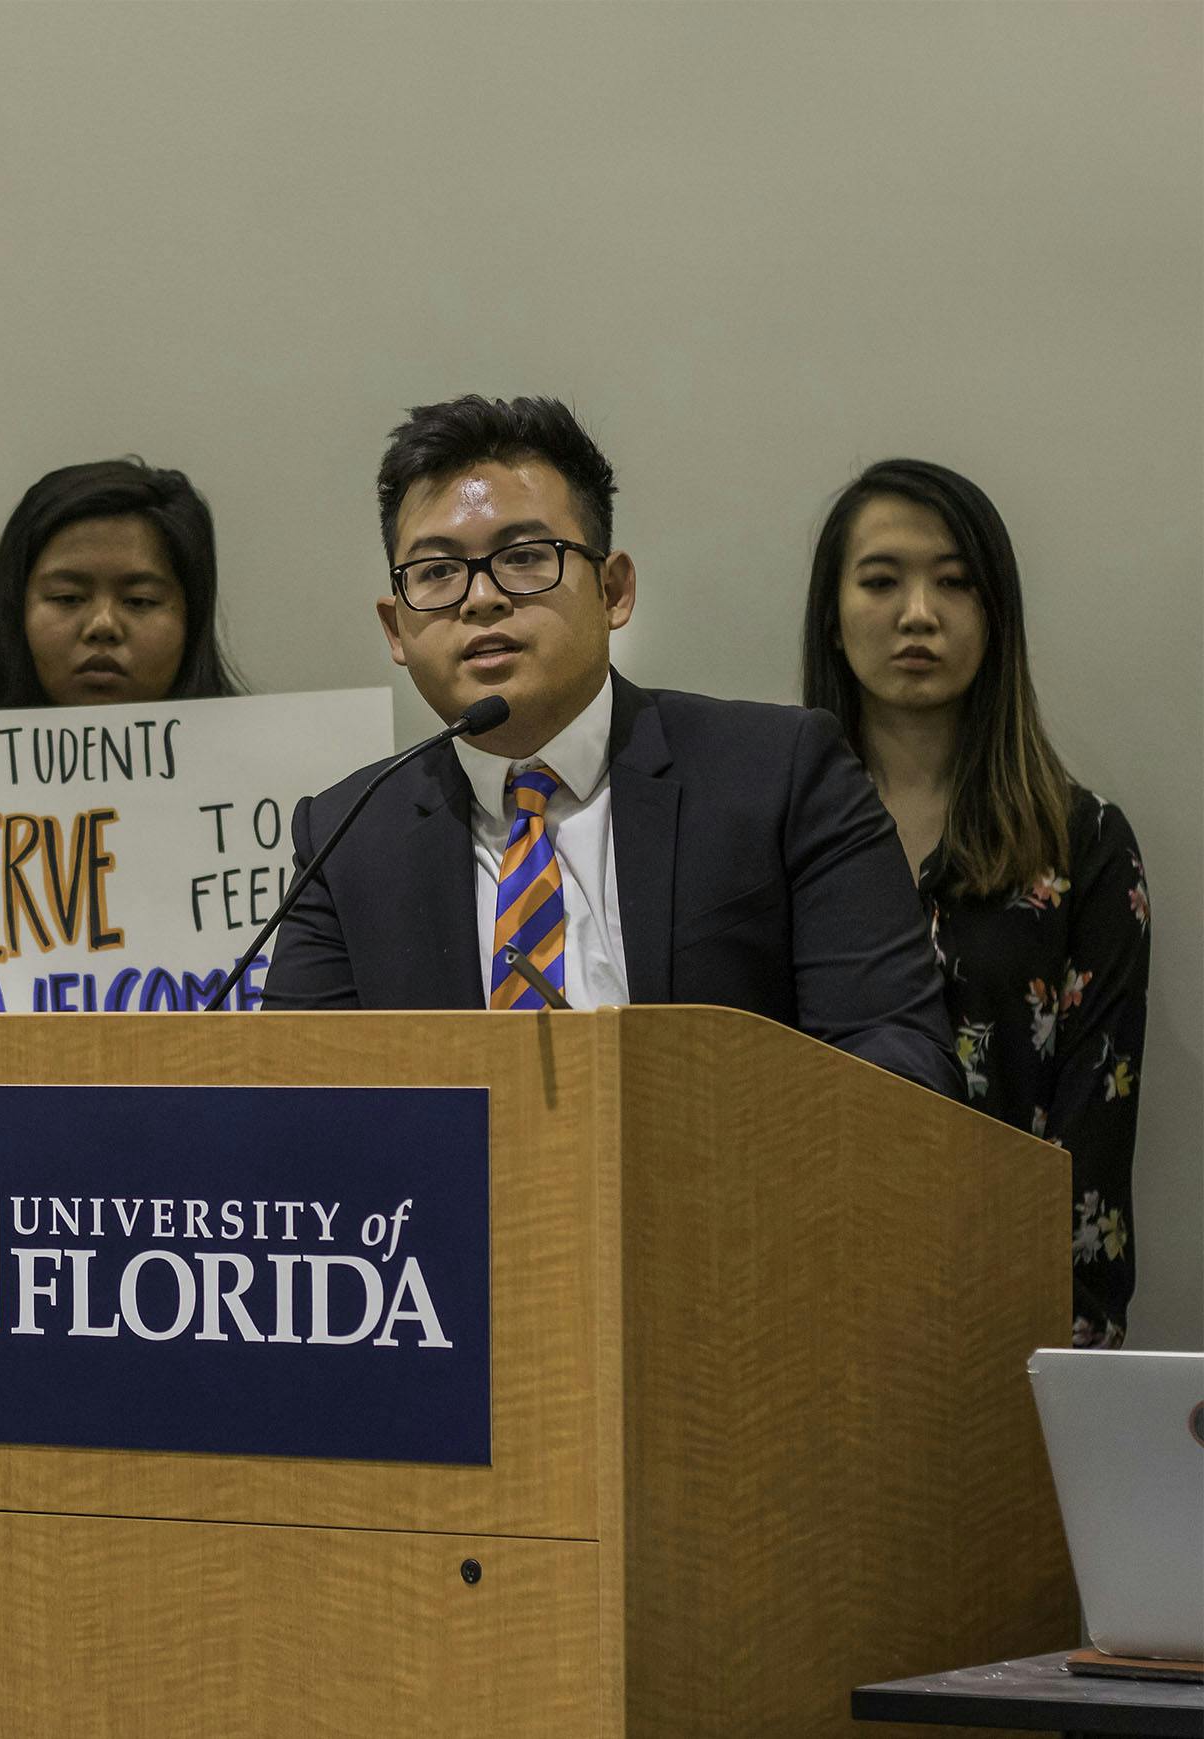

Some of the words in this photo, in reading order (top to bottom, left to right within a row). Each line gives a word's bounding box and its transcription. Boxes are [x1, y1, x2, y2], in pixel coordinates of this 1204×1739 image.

[199, 798, 281, 853] TO
[11, 1196, 340, 1242] UNIVERSITY
[361, 1199, 413, 1261] of
[10, 1247, 453, 1349] FLORIDA
